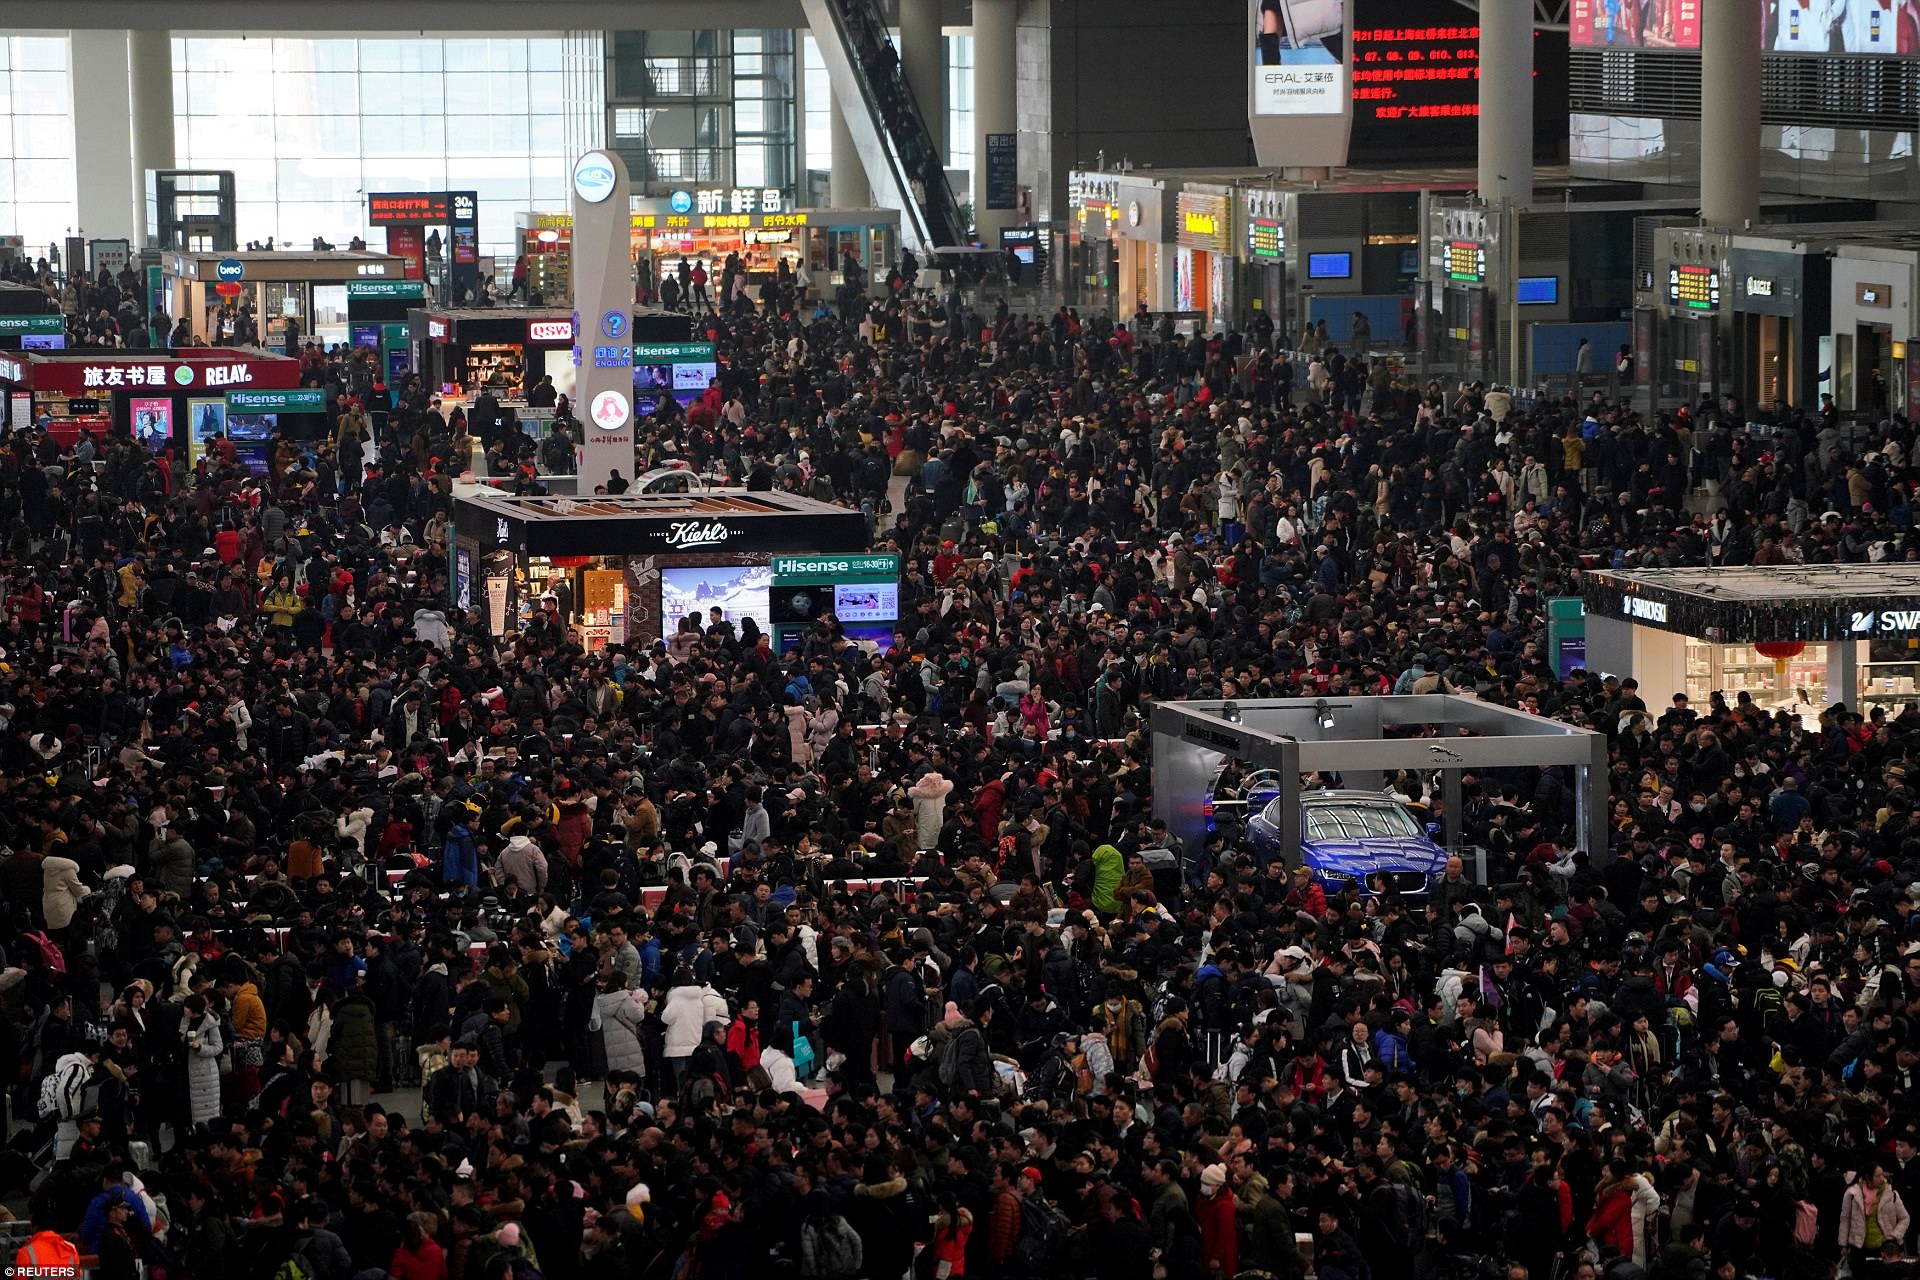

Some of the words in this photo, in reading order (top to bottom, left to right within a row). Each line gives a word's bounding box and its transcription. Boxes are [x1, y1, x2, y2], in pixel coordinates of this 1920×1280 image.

[1264, 73, 1300, 84] ERAL
[1304, 72, 1334, 83] 艾莱依
[697, 189, 781, 214] 新鲜岛
[219, 264, 242, 275] breo
[351, 283, 394, 292] Hisense
[533, 324, 570, 338] QSW
[622, 346, 631, 358] 2
[83, 365, 167, 387] 旅友书屋
[205, 364, 248, 386] RELAY
[231, 393, 286, 404] Hisense
[666, 521, 728, 547] Kiehl's
[778, 560, 849, 573] Hisense
[1632, 596, 1667, 623] SWAROVSKI
